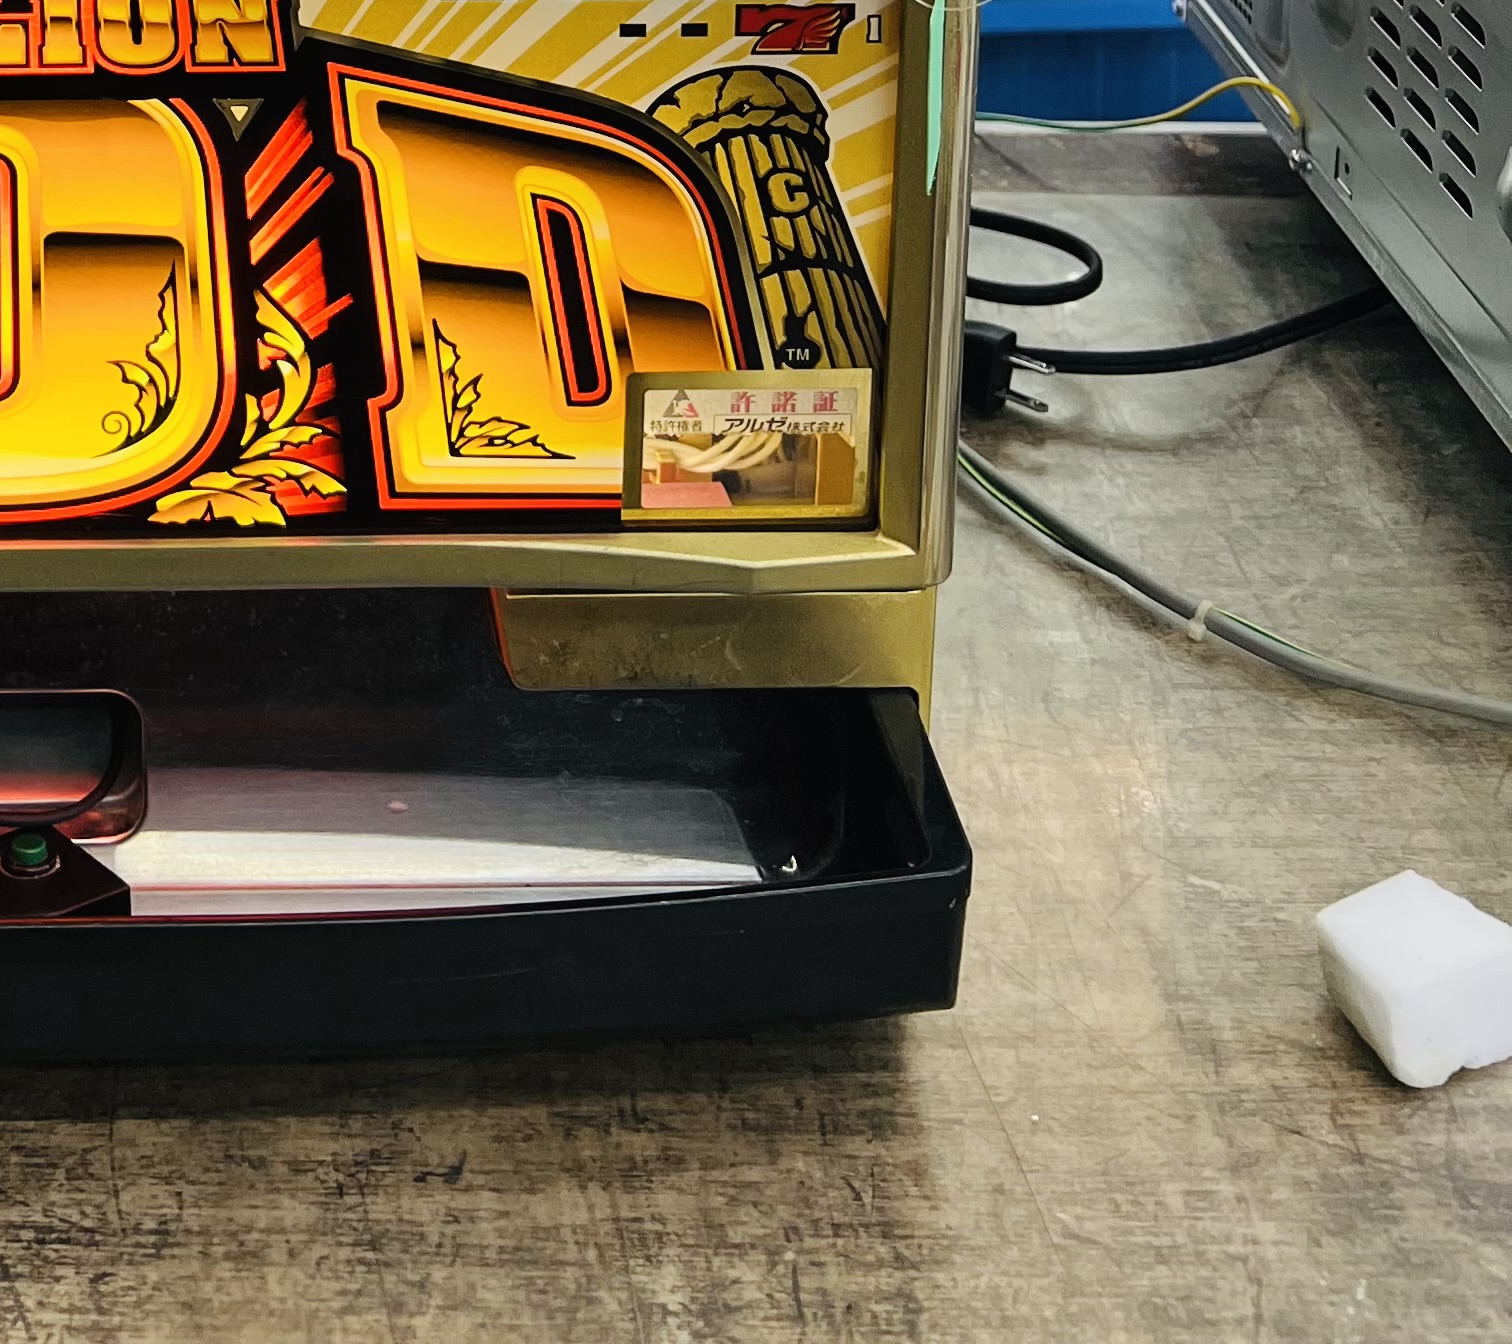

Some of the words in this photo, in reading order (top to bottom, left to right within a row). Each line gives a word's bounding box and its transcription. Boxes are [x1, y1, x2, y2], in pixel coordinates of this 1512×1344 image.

[734, 2, 856, 55] 7
[866, 14, 882, 43] 1
[786, 348, 810, 361] TM
[730, 391, 839, 414] 許諾証
[650, 420, 703, 432] 特許権者
[722, 416, 846, 434] アルゼ株式会社
